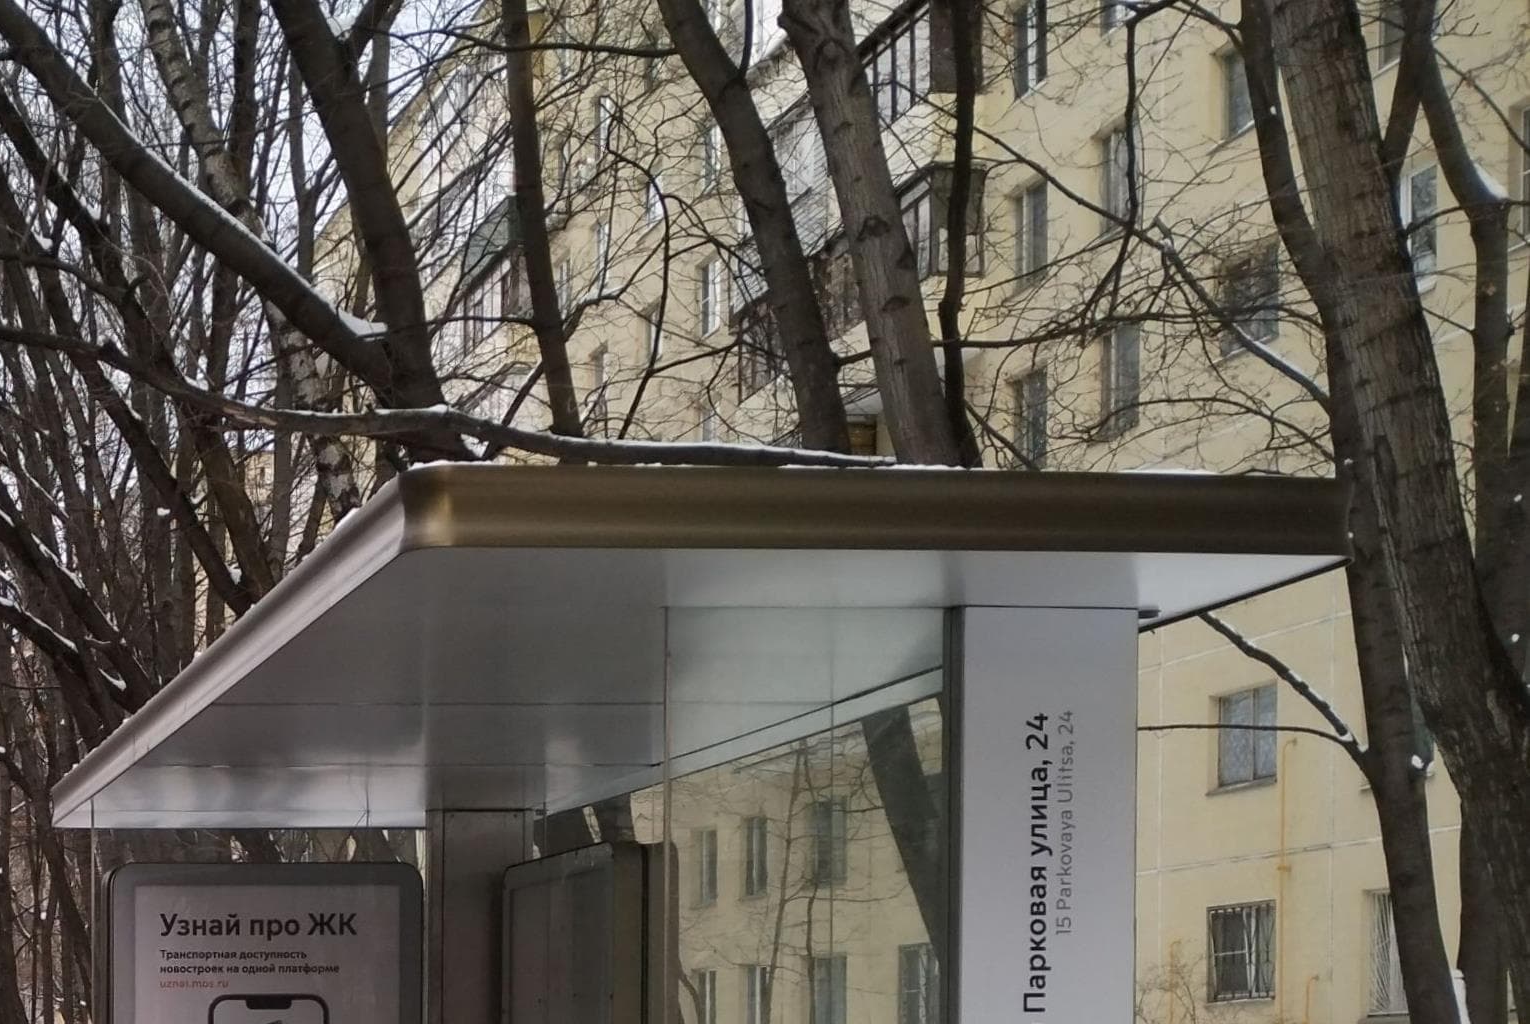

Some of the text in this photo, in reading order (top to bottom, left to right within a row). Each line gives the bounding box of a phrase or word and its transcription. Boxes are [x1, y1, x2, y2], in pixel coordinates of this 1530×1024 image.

[1026, 712, 1048, 750] 24
[1030, 759, 1053, 857] улица,
[1056, 710, 1076, 935] 15 Parkovaya Ulitsa, 24
[159, 913, 357, 941] Узнай про ЖК
[1023, 866, 1051, 1012] Парковая
[160, 950, 307, 961] Транспортная доступность
[160, 963, 340, 976] новостроек на одной платформе
